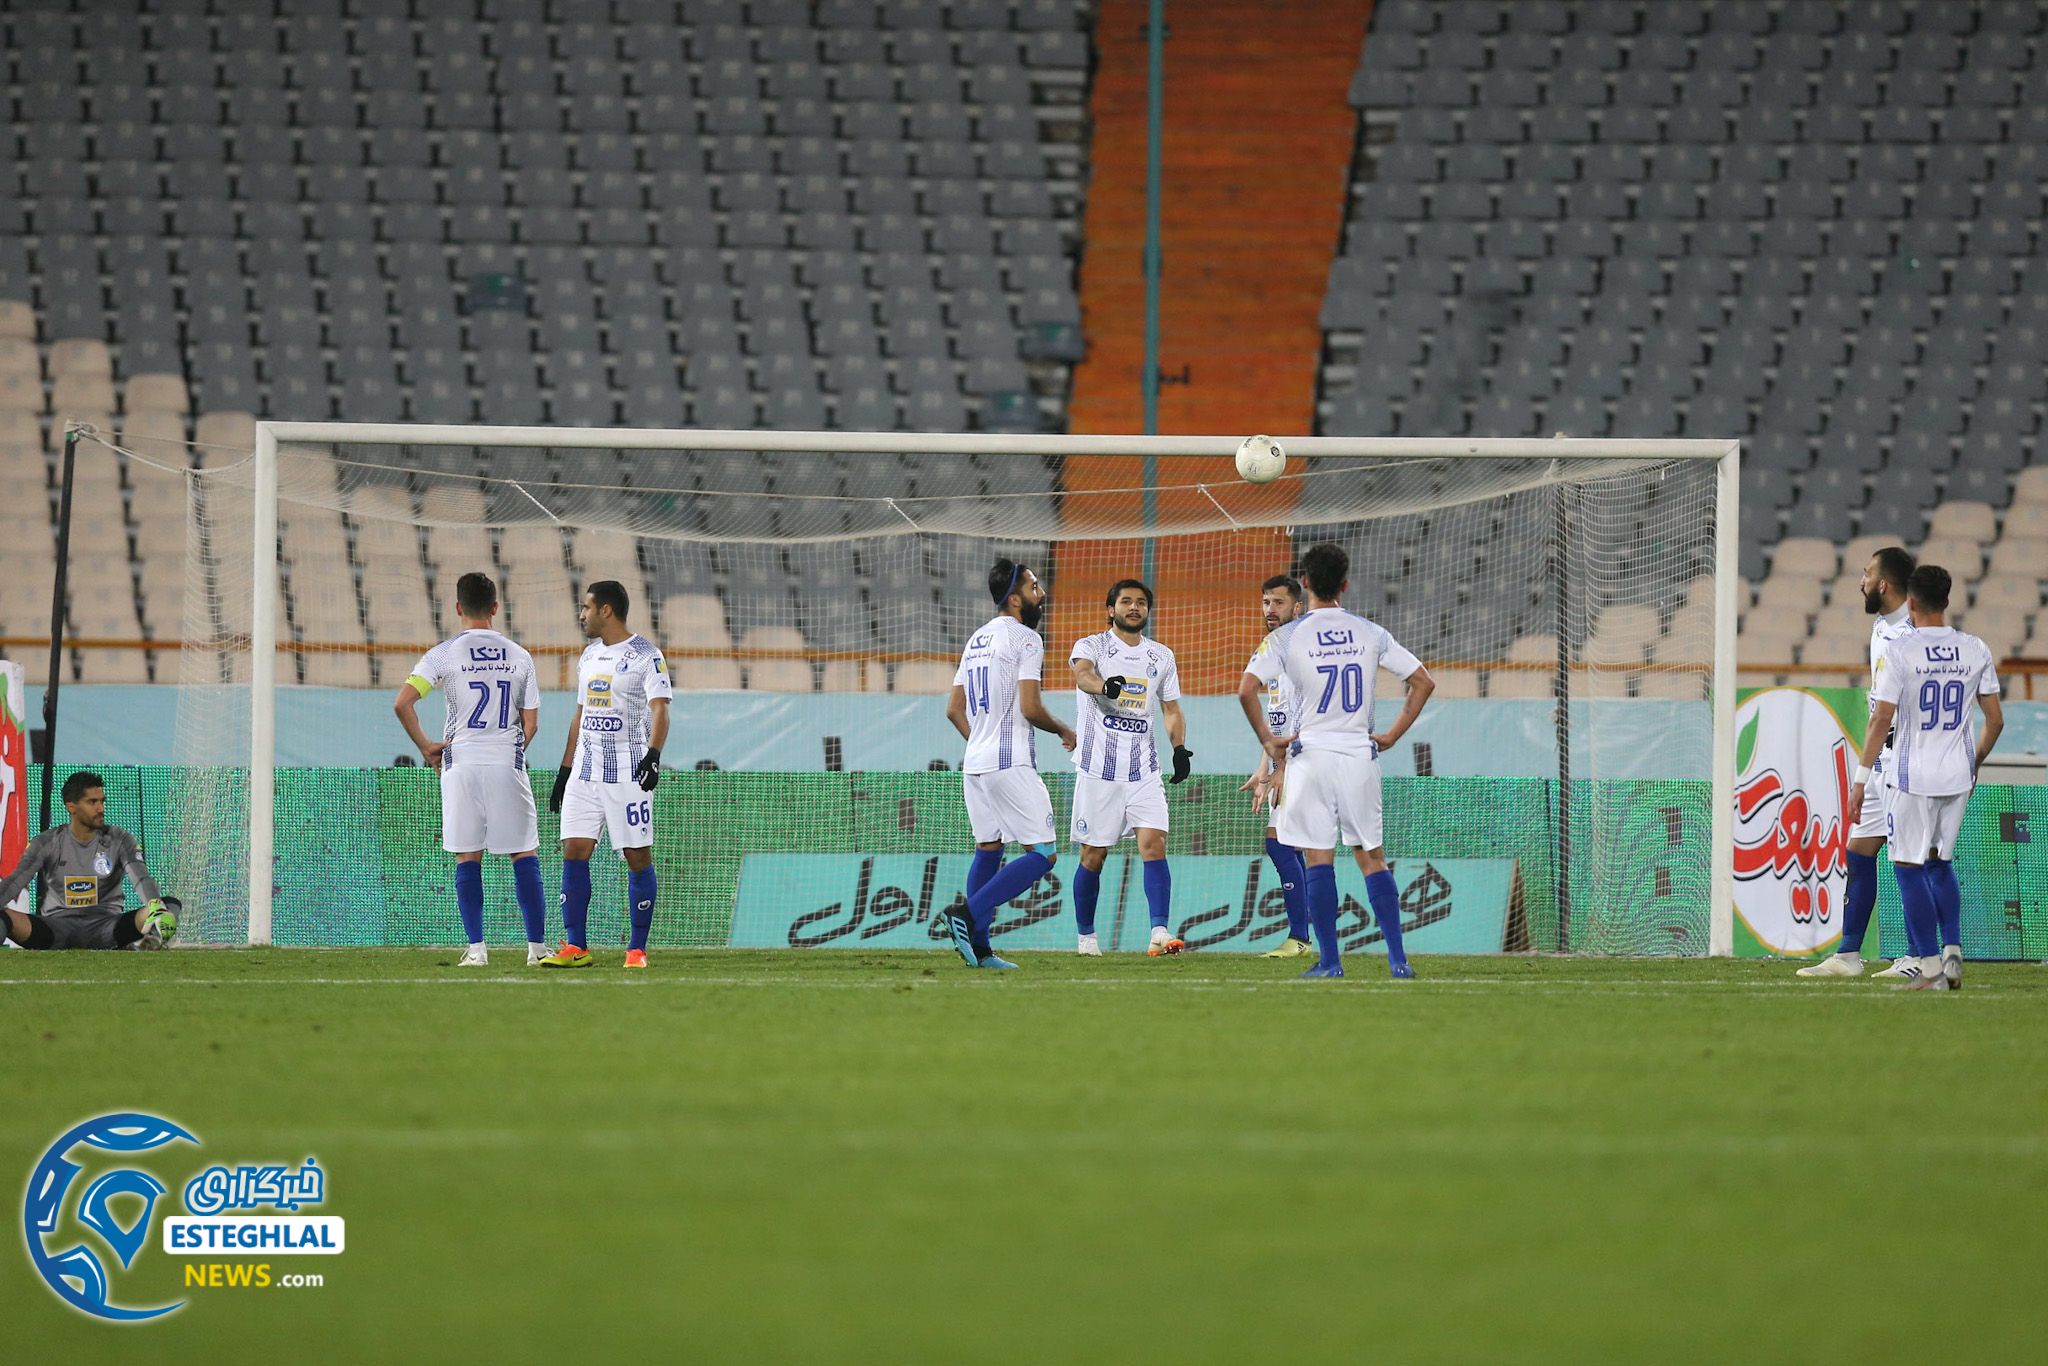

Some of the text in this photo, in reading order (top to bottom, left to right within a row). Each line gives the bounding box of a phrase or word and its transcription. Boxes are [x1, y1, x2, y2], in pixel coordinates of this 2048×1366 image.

[467, 680, 511, 729] 21
[1120, 700, 1143, 708] MTN
[1316, 663, 1363, 714] 70
[1919, 679, 1965, 732] 99
[625, 800, 650, 827] 66
[70, 897, 93, 906] MTN
